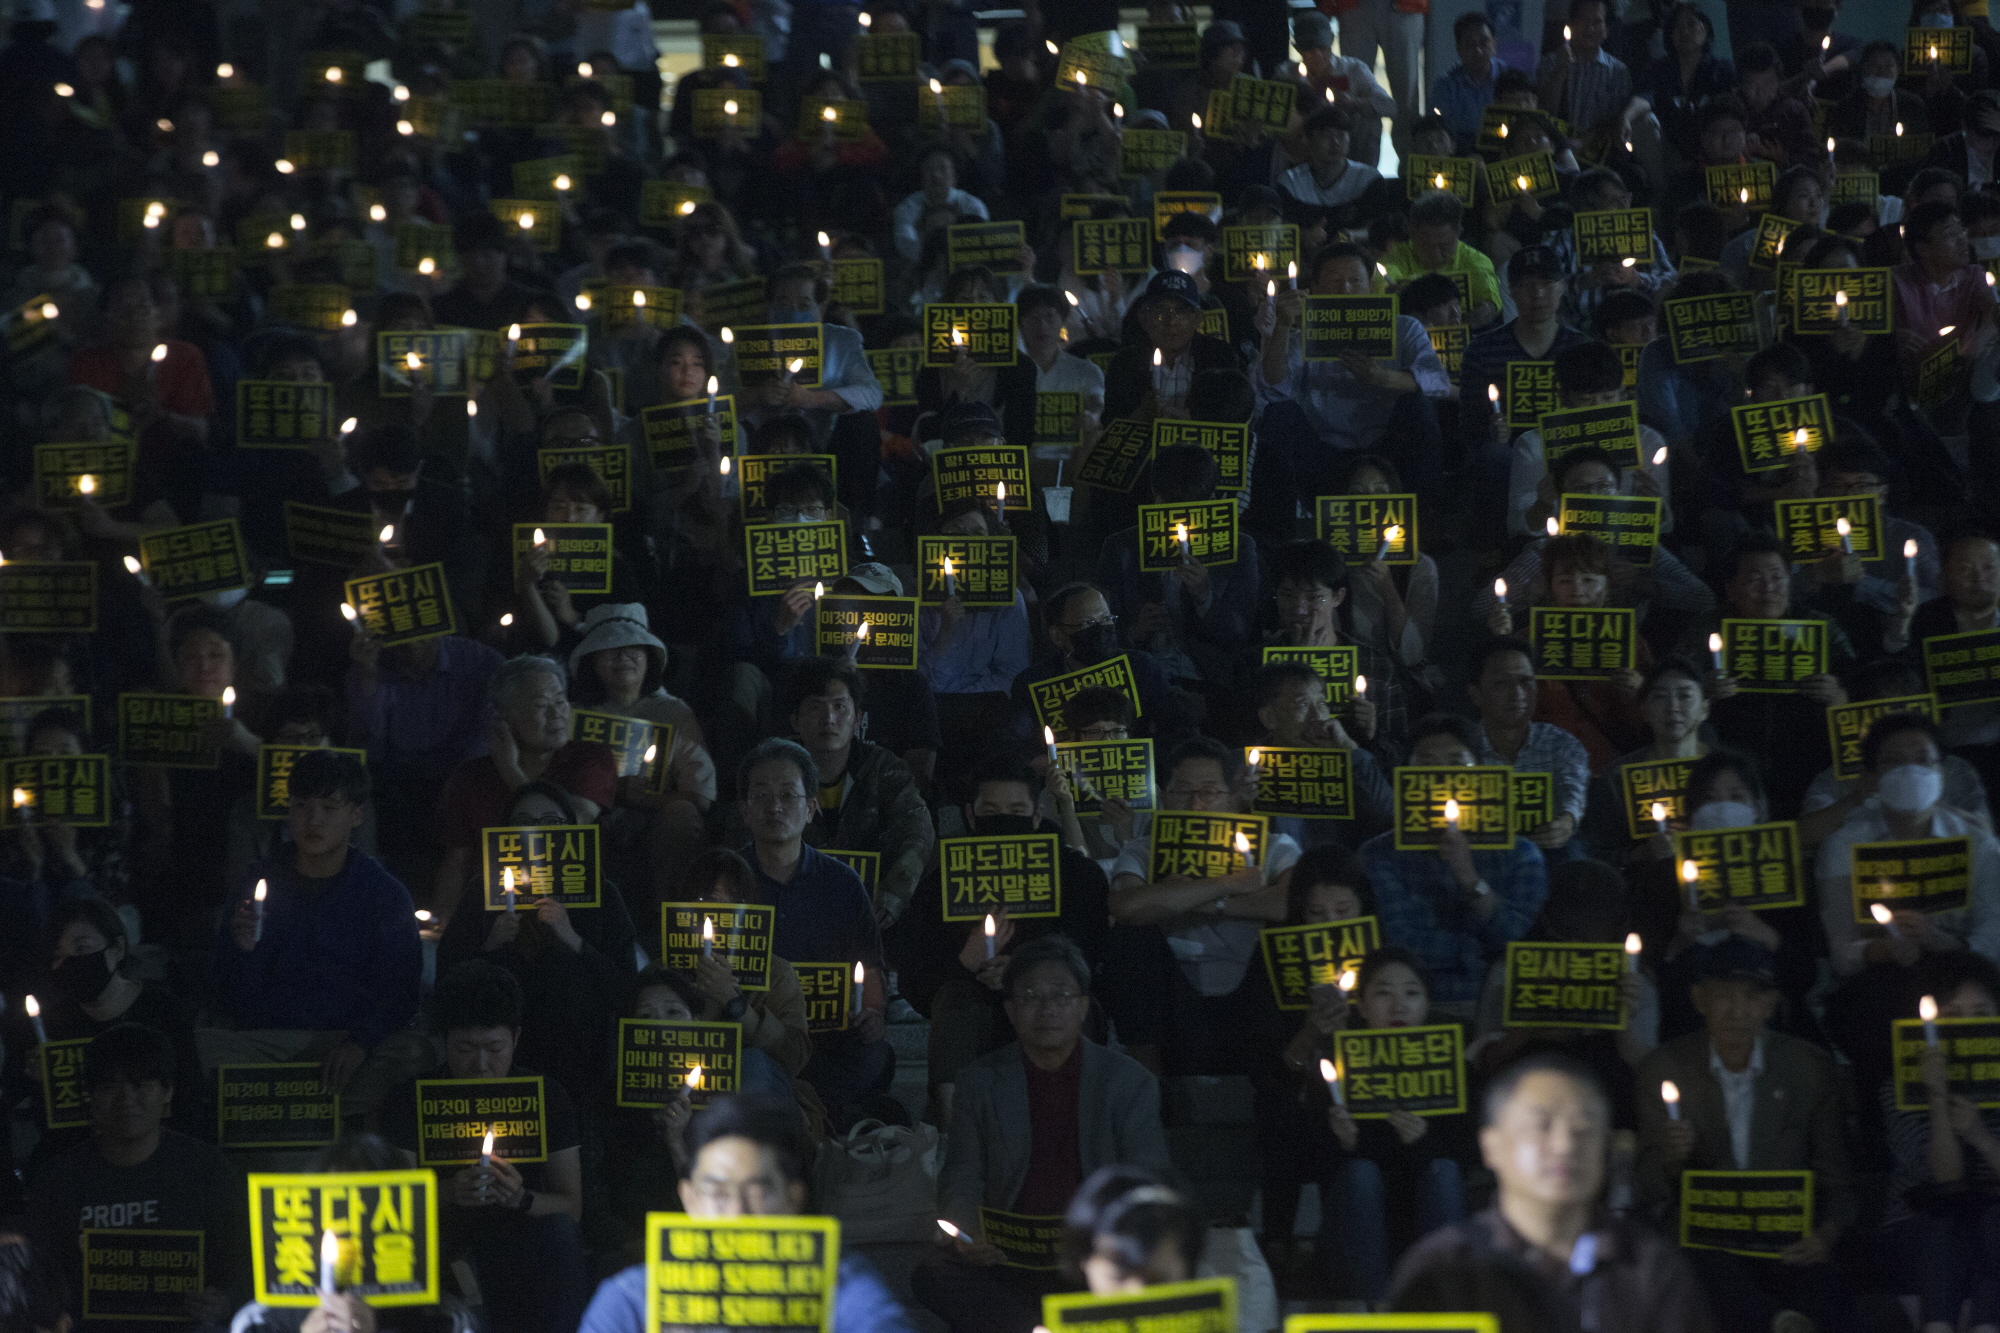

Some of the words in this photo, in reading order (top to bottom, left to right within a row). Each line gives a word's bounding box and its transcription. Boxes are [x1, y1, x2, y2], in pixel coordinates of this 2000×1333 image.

[1083, 224, 1141, 242] 또다시
[1581, 212, 1646, 233] 파도파도
[1229, 229, 1295, 247] 파도파도
[1582, 234, 1647, 255] 거짓말뿐
[1083, 244, 1142, 266] 촛불을
[1802, 275, 1884, 297] 입시농단
[931, 308, 1010, 330] 강남양파
[1307, 310, 1341, 323] 이것이
[1345, 308, 1392, 323] 정의인가
[1673, 301, 1749, 323] 입시농단
[1307, 326, 1353, 341] 대답하라
[1358, 326, 1392, 341] 문재인
[248, 386, 322, 411] 또다시
[1586, 416, 1633, 436] 정의인가
[1747, 401, 1817, 434] 또다시
[945, 453, 962, 468] 딸!
[967, 453, 1017, 467] 모릅니다
[941, 470, 970, 484] 아내!
[975, 468, 1024, 483] 모릅니다
[1147, 506, 1231, 533] 파도파도
[1329, 505, 1405, 526] 또다시
[1566, 510, 1603, 524] 이것이
[1608, 511, 1656, 526] 정의인가
[1788, 500, 1867, 528] 또다시
[152, 529, 234, 562] 파도파도
[559, 541, 606, 553] 정의인가
[753, 527, 838, 553] 강남양파
[570, 559, 606, 573] 문재인
[925, 542, 1008, 566] 파도파도
[756, 553, 839, 581] 조국파면
[359, 570, 436, 611] 또다시
[363, 598, 441, 636] 촛불을
[821, 610, 858, 626] 이것이
[863, 612, 914, 628] 정의인가
[1543, 612, 1622, 640] 또다시
[875, 632, 912, 648] 문재인
[1735, 625, 1815, 653] 또다시
[1543, 643, 1623, 668] 촛불을
[1736, 653, 1816, 681] 촛불을
[583, 717, 660, 745] 또다시
[1059, 745, 1146, 774] 파도파도
[1257, 751, 1344, 778] 강남양파
[15, 761, 97, 785] 또다시
[1259, 778, 1344, 806] 조국파면
[1405, 773, 1504, 801] 강남양파
[1158, 817, 1257, 848] 파도파도
[498, 832, 585, 862] 또다시
[950, 843, 1050, 872] 파도파도
[1691, 832, 1782, 861] 또다시
[952, 875, 1052, 904] 거짓말뿐
[676, 911, 697, 928] 딸!
[703, 911, 762, 930] 모릅니다
[712, 934, 767, 951] 모릅니다
[1274, 925, 1366, 965] 또다시
[1517, 950, 1619, 980] 입시농단
[1517, 983, 1615, 1009] 조국OUT!
[634, 1029, 656, 1046] 딸!
[662, 1030, 725, 1049] 모릅니다
[626, 1051, 663, 1068] 아내!
[669, 1052, 733, 1070] 모릅니다
[1346, 1037, 1452, 1068] 입시농단
[225, 1082, 269, 1098] 이것이
[626, 1072, 663, 1089] 조카!
[1350, 1070, 1453, 1099] 조국OUT!
[225, 1106, 283, 1121] 대답하라
[290, 1104, 334, 1120] 문재인
[424, 1099, 469, 1115] 이것이
[477, 1098, 538, 1114] 정의인가
[425, 1121, 487, 1138] 대답하라
[494, 1119, 539, 1137] 문재인
[274, 1186, 414, 1235] 또다시
[89, 1249, 134, 1266] 이것이
[139, 1249, 199, 1268] 정의인가
[89, 1276, 148, 1291] 대답하라
[155, 1275, 199, 1293] 문재인
